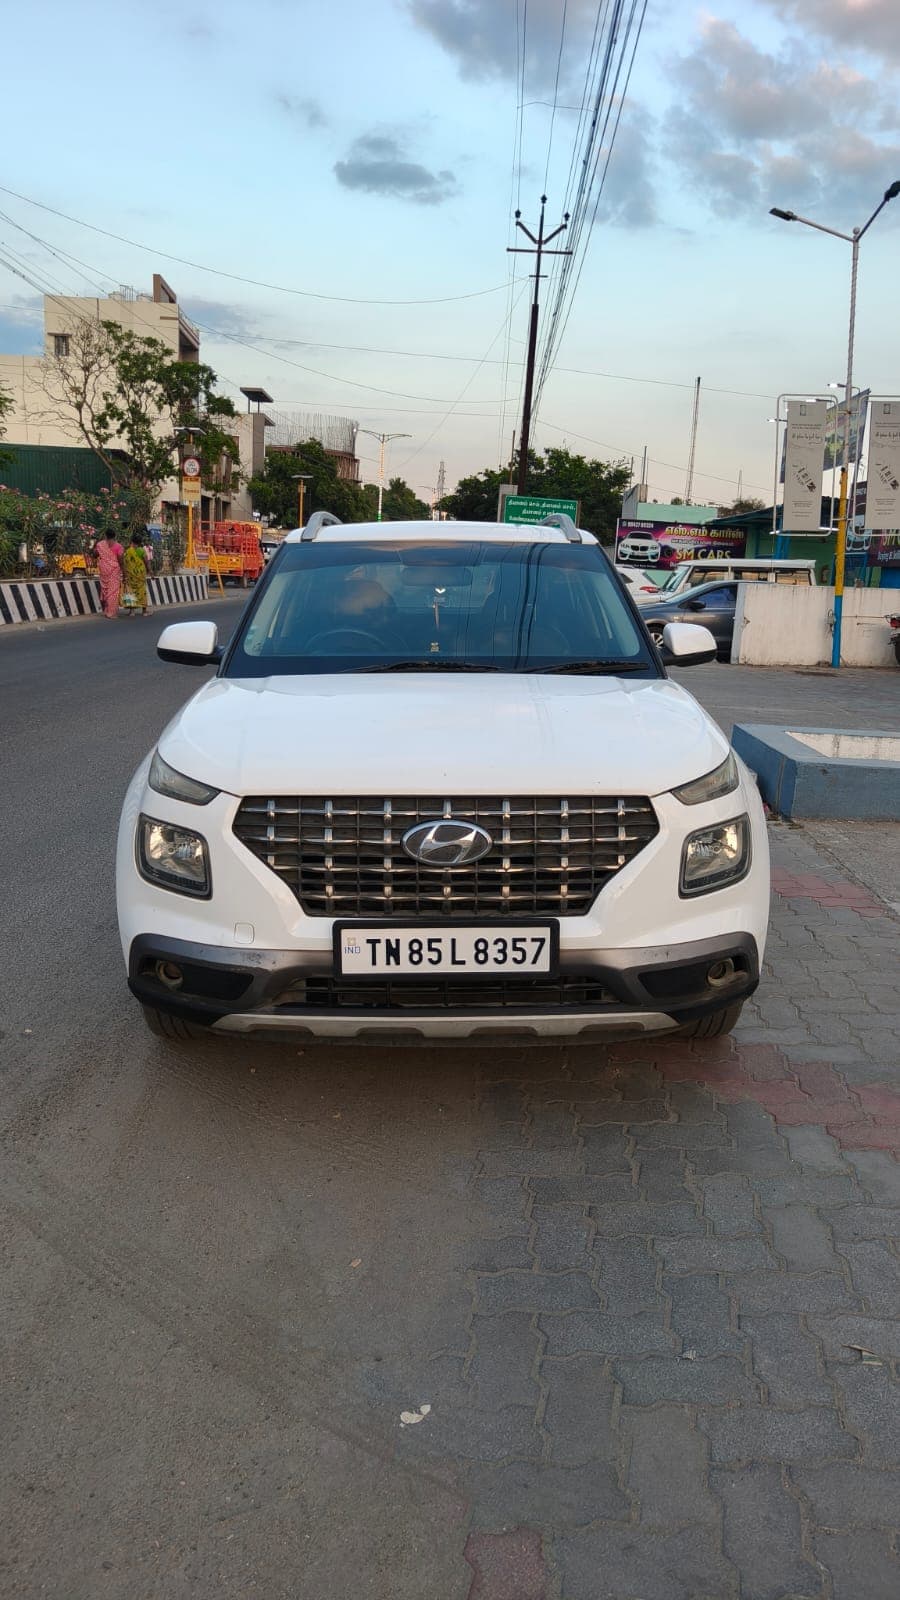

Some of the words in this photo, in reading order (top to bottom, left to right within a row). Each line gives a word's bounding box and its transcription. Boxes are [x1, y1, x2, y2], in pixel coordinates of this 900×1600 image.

[676, 548, 695, 560] SM
[697, 548, 732, 560] CARS
[366, 938, 400, 966] TN
[408, 938, 442, 965] 85
[451, 938, 466, 965] L
[474, 937, 546, 965] 8357
